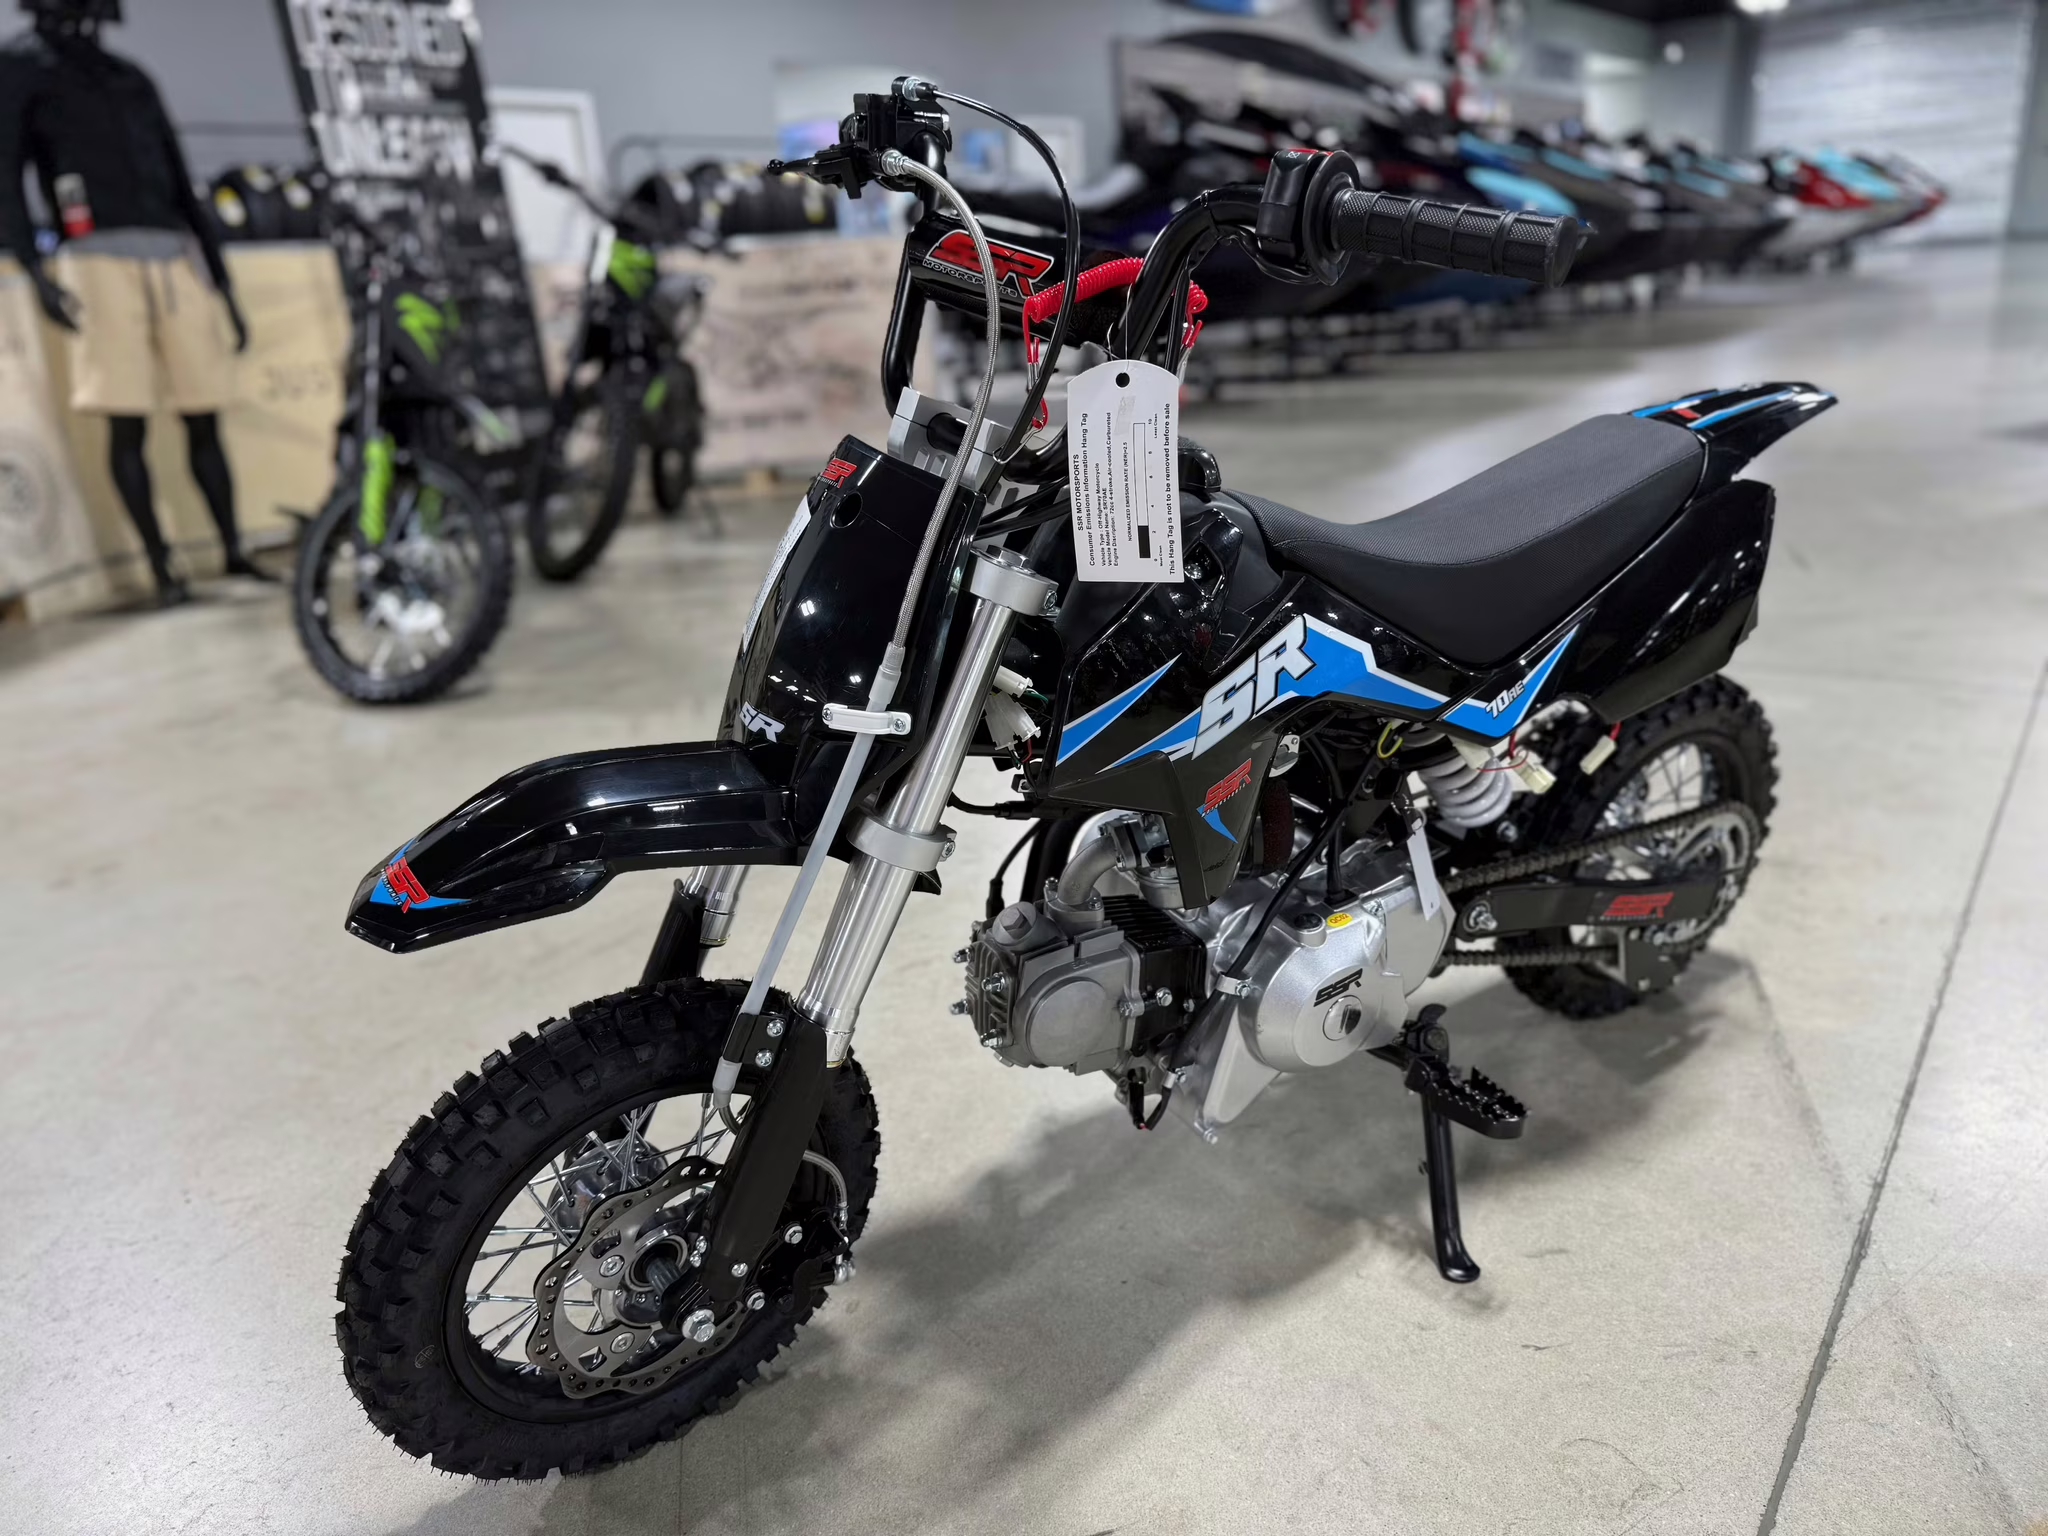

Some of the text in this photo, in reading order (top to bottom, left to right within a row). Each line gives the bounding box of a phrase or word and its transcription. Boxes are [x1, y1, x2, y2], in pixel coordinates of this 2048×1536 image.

[922, 259, 1018, 298] MOTORSPTS
[1081, 450, 1089, 492] Information
[1165, 483, 1171, 492] be
[1073, 454, 1084, 531] SSR MOTORSPORTS
[1082, 493, 1092, 530] Emissions
[1166, 493, 1171, 501] to
[1086, 531, 1095, 566] Consumer
[1192, 614, 1316, 760] SR
[1485, 680, 1525, 719] 70AE
[1203, 758, 1252, 812] SSR
[1313, 968, 1363, 1007] SSR
